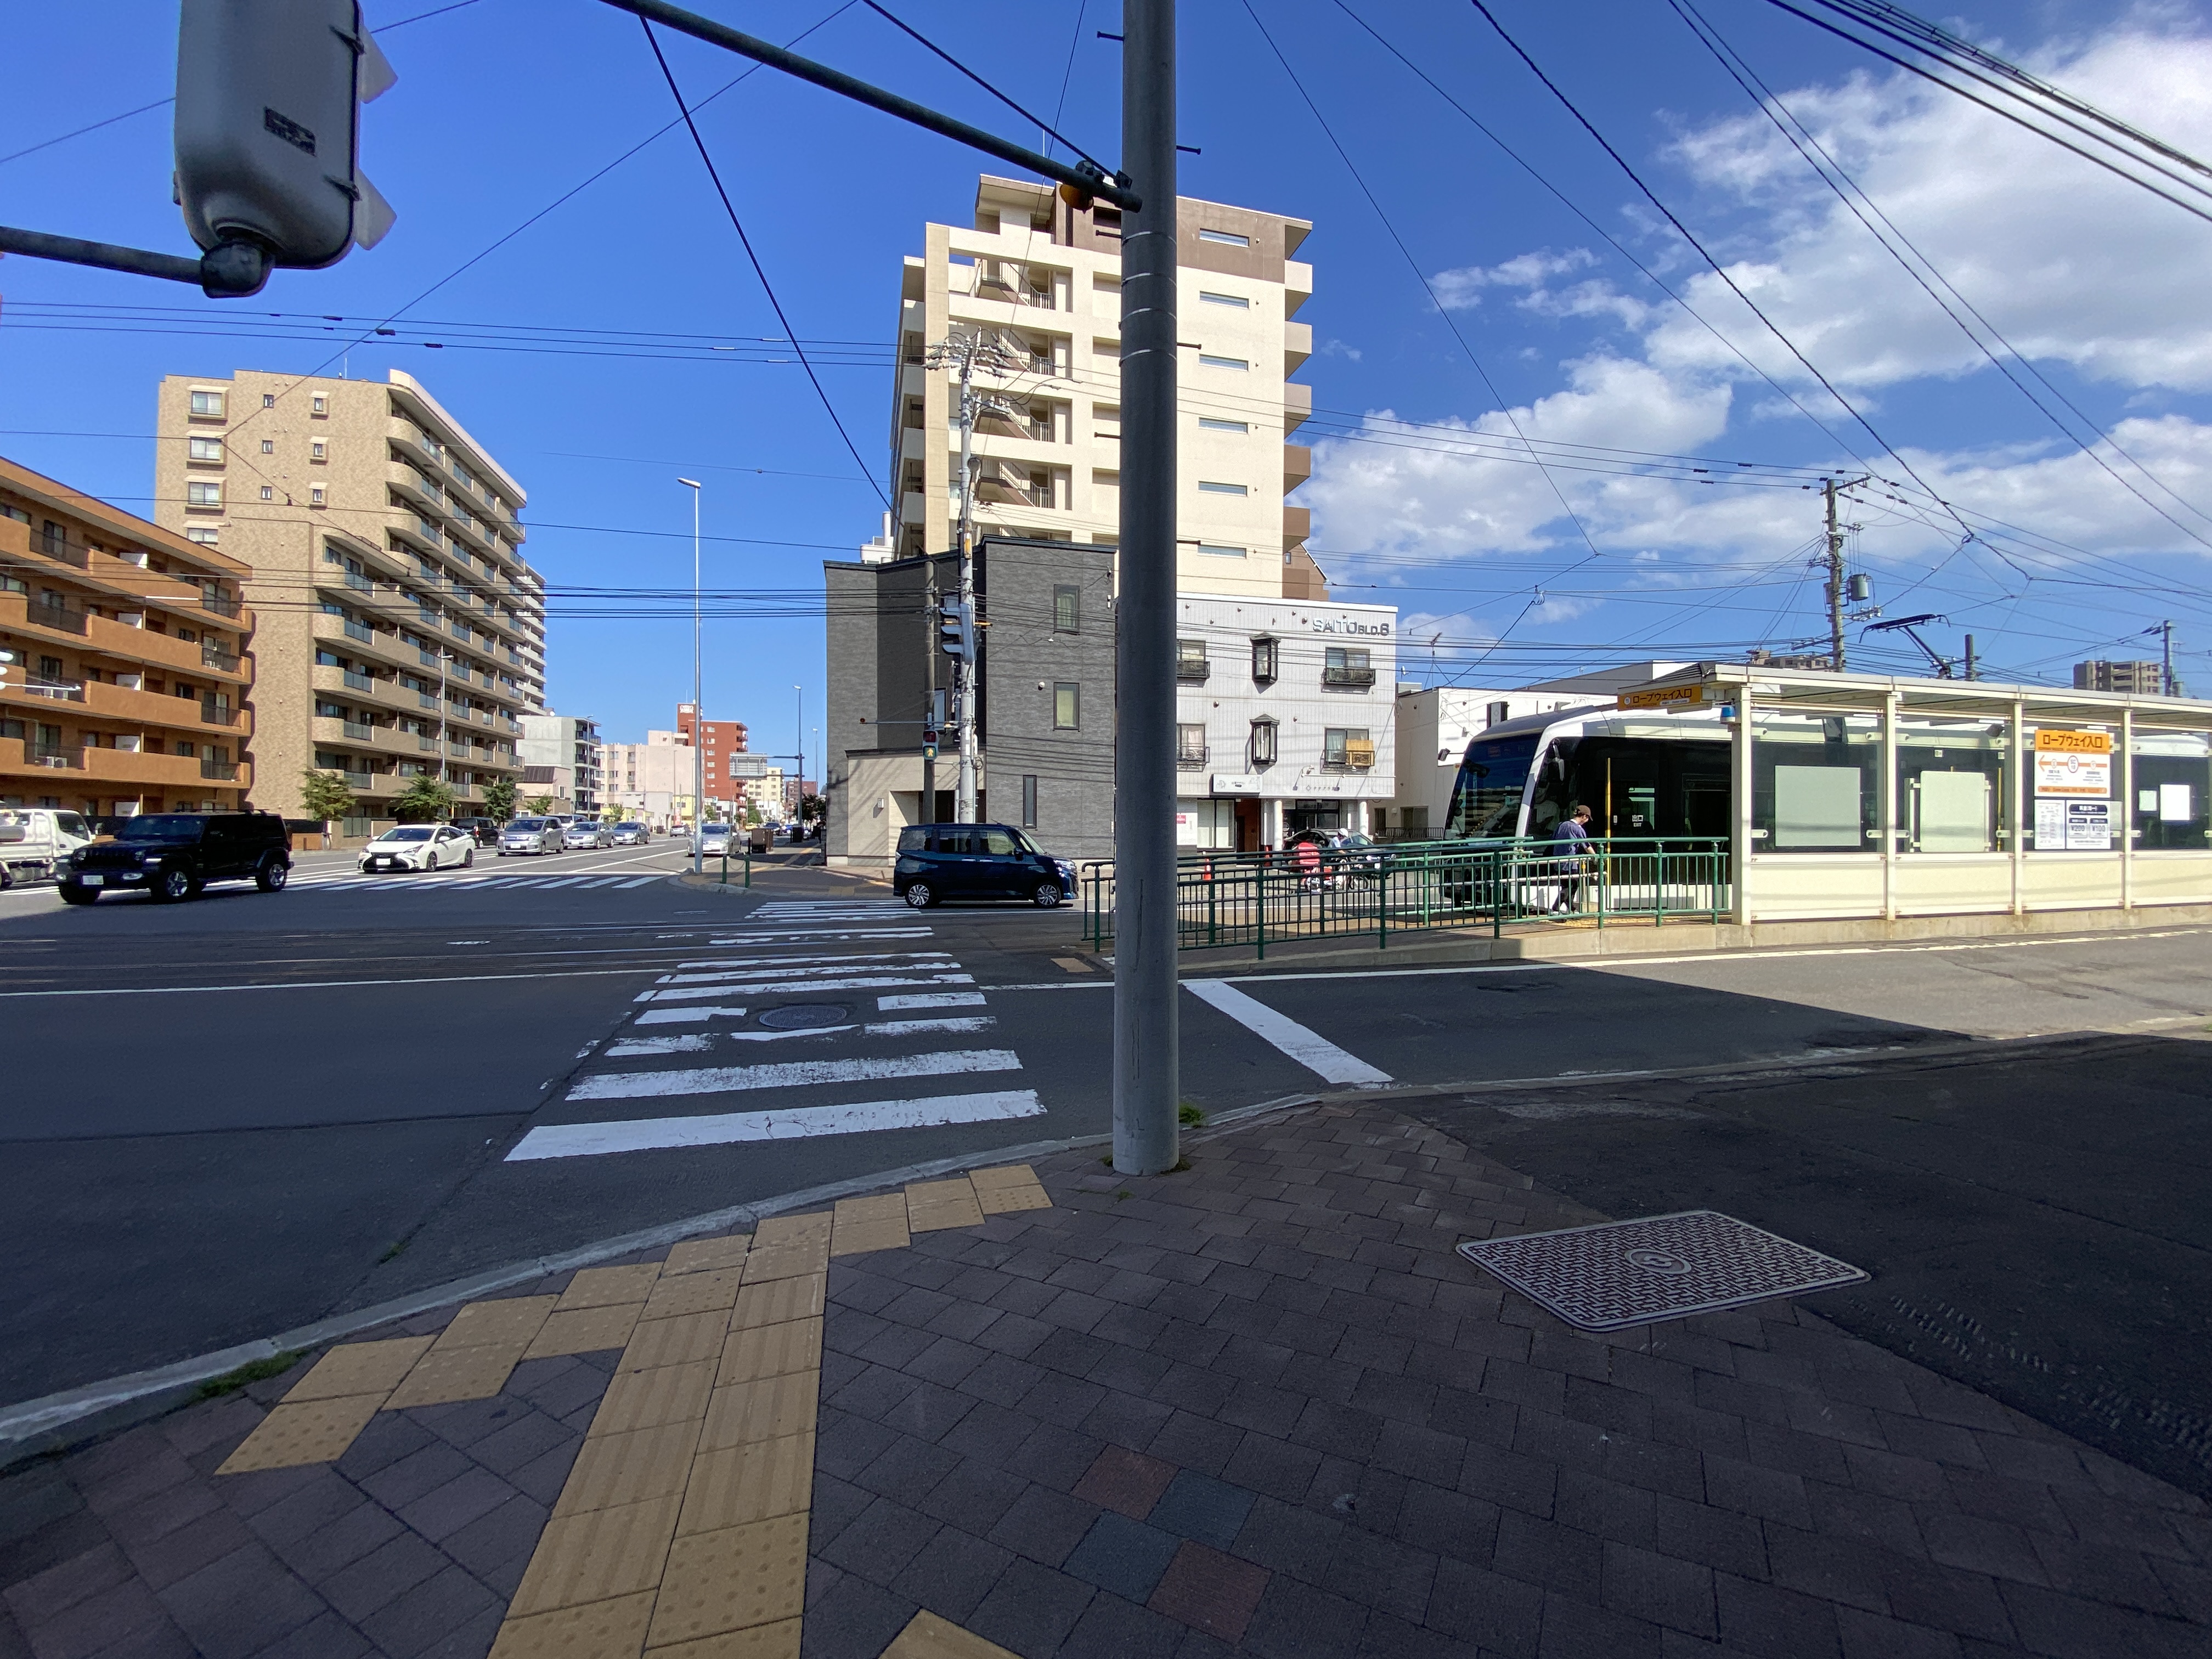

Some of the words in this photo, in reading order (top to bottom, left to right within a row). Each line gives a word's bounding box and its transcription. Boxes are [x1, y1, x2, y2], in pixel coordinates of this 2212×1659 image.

[1313, 618, 1357, 634] SAITO
[1633, 689, 1692, 703] ロープウェイ入口
[2043, 734, 2102, 748] ロープウェイ入口
